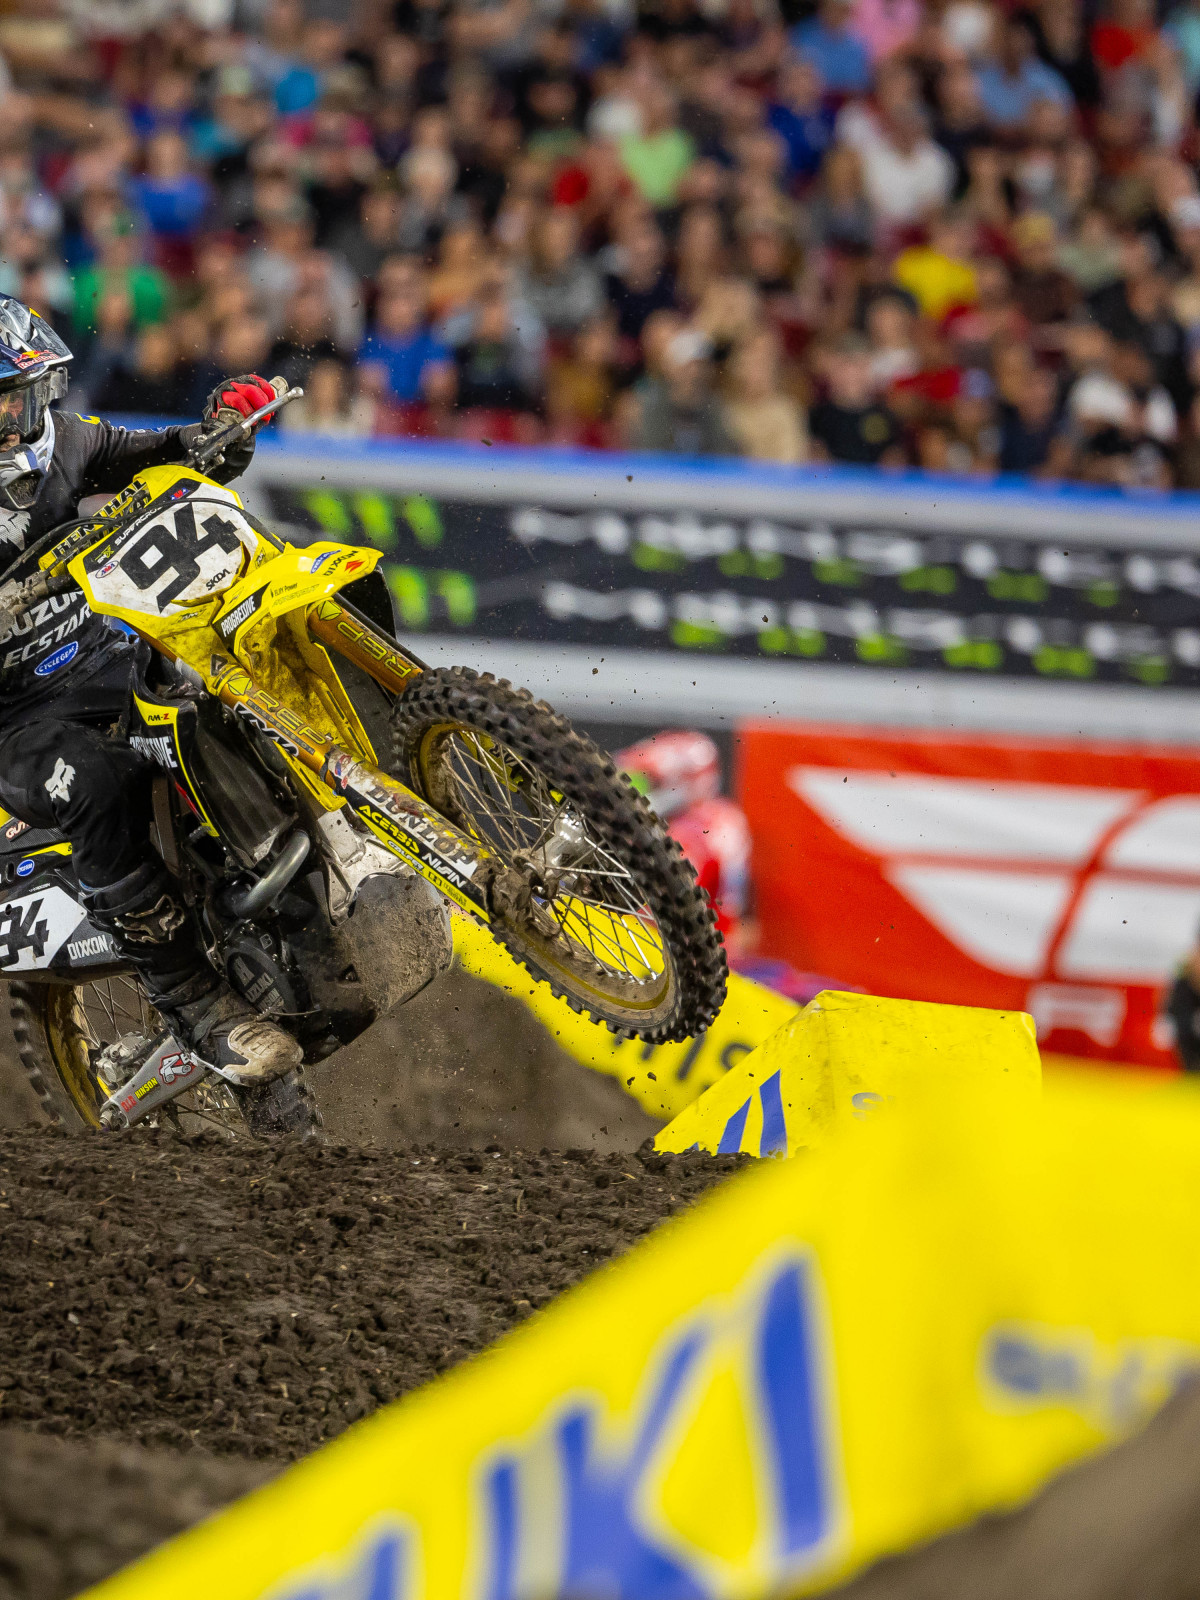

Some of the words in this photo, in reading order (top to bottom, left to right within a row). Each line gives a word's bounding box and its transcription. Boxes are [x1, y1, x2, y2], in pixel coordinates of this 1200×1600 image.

[115, 506, 163, 546] SUPERCRO
[119, 502, 242, 614] 94
[323, 551, 360, 577] DIXXON
[221, 595, 256, 638] PROGRESSIVE
[3, 602, 93, 668] ECSTAR
[38, 654, 60, 672] CYCLE
[60, 645, 75, 661] GEAR
[148, 713, 170, 722] RM-Z
[253, 689, 325, 745] REP
[366, 785, 478, 865] DUNLOP
[66, 934, 108, 961] DIXXON
[244, 971, 276, 1003] UZUKI
[134, 1077, 159, 1099] HINSON
